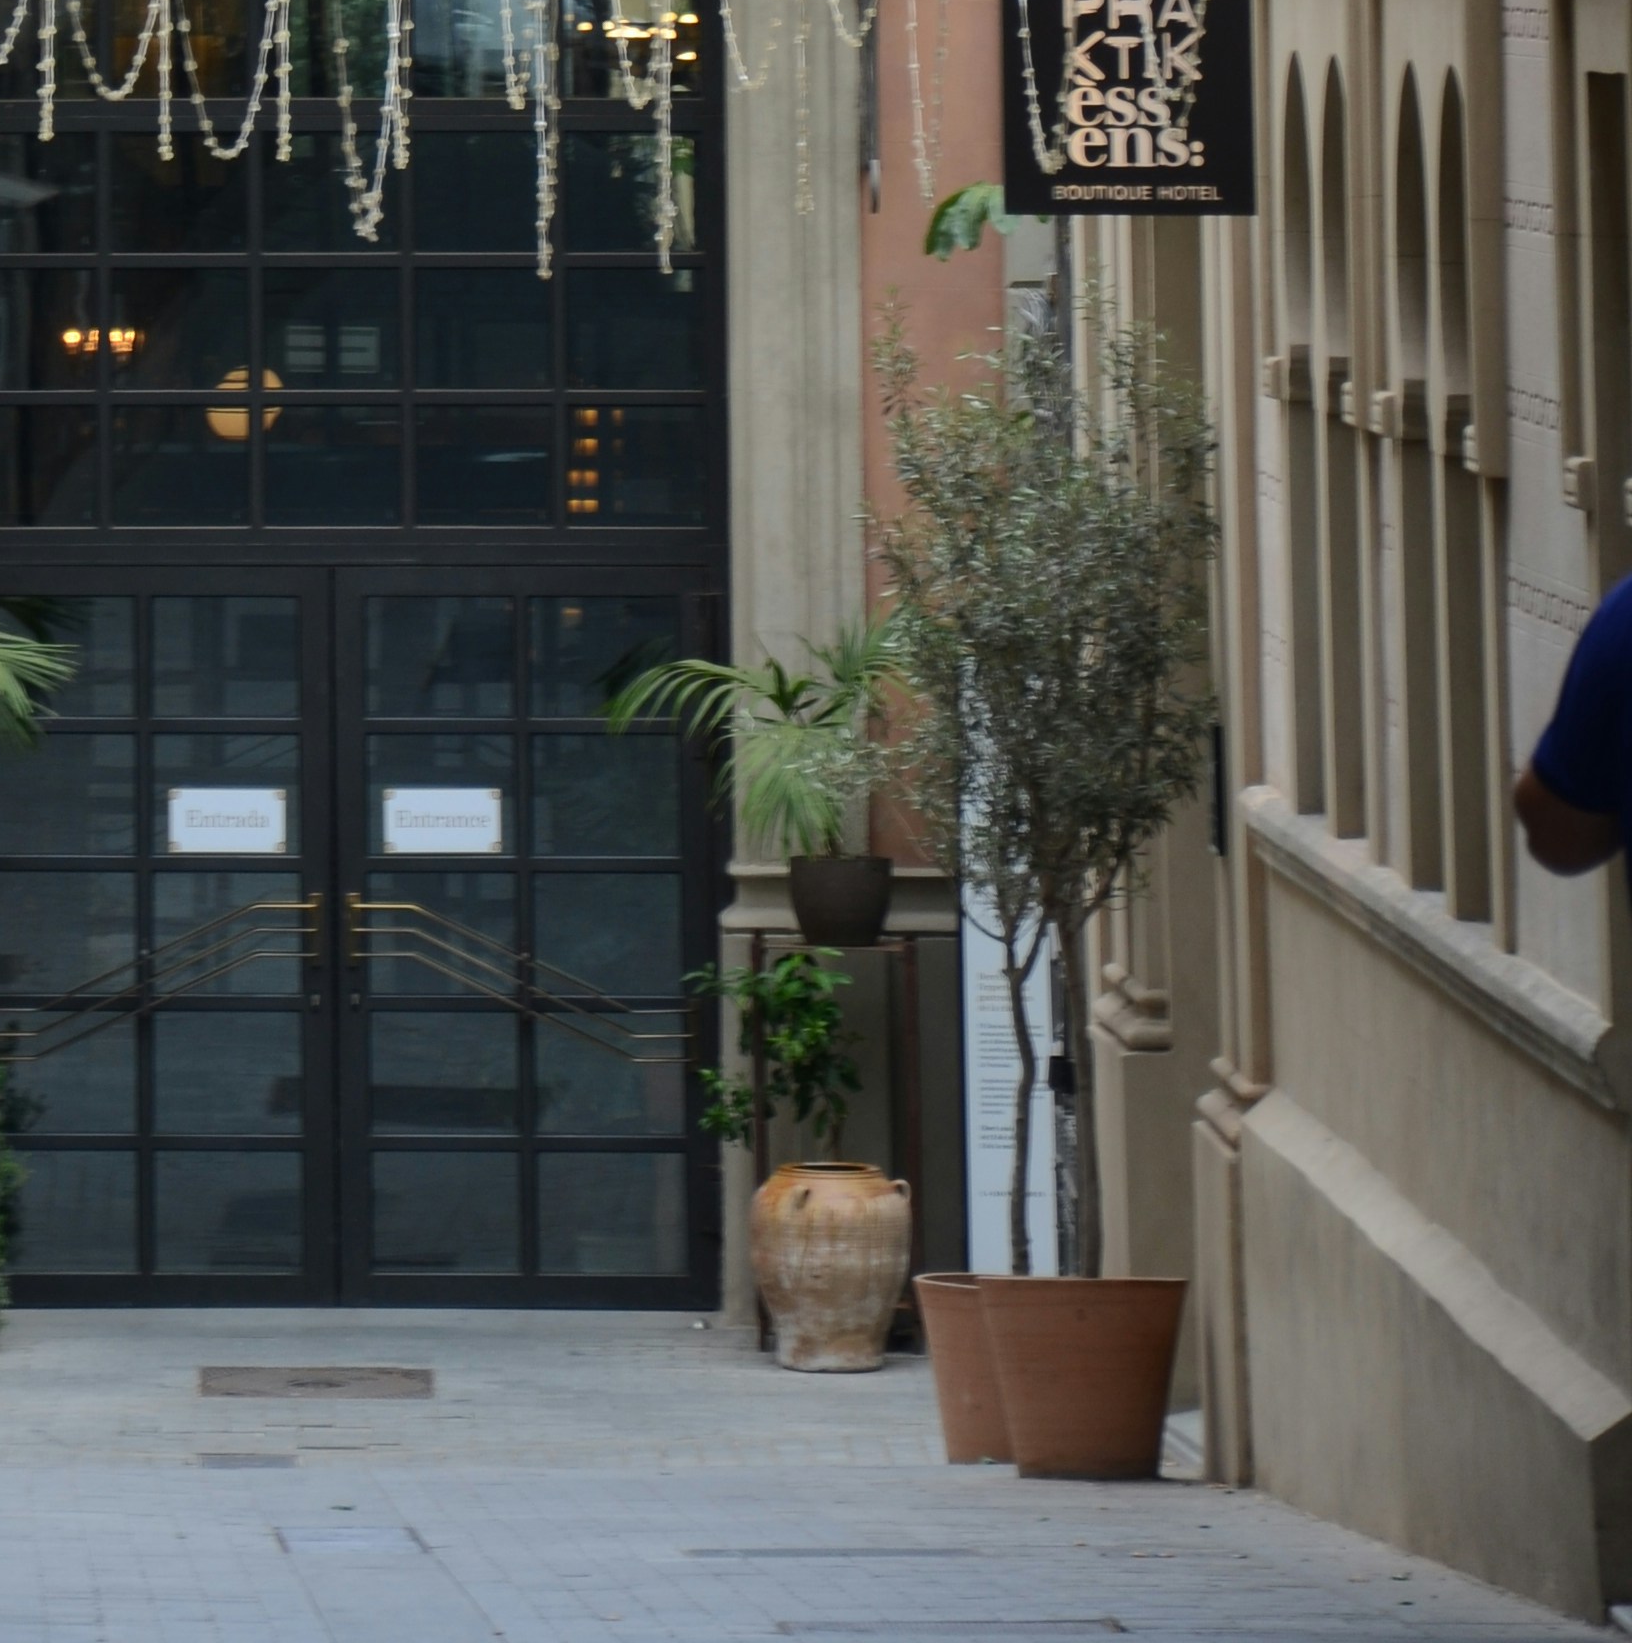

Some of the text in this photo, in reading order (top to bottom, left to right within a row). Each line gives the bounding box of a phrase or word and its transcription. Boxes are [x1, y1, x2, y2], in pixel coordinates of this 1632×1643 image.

[1052, 184, 1223, 201] BOUTIQUE HOTEL
[184, 809, 270, 829] Entrada
[395, 809, 491, 829] Entrance
